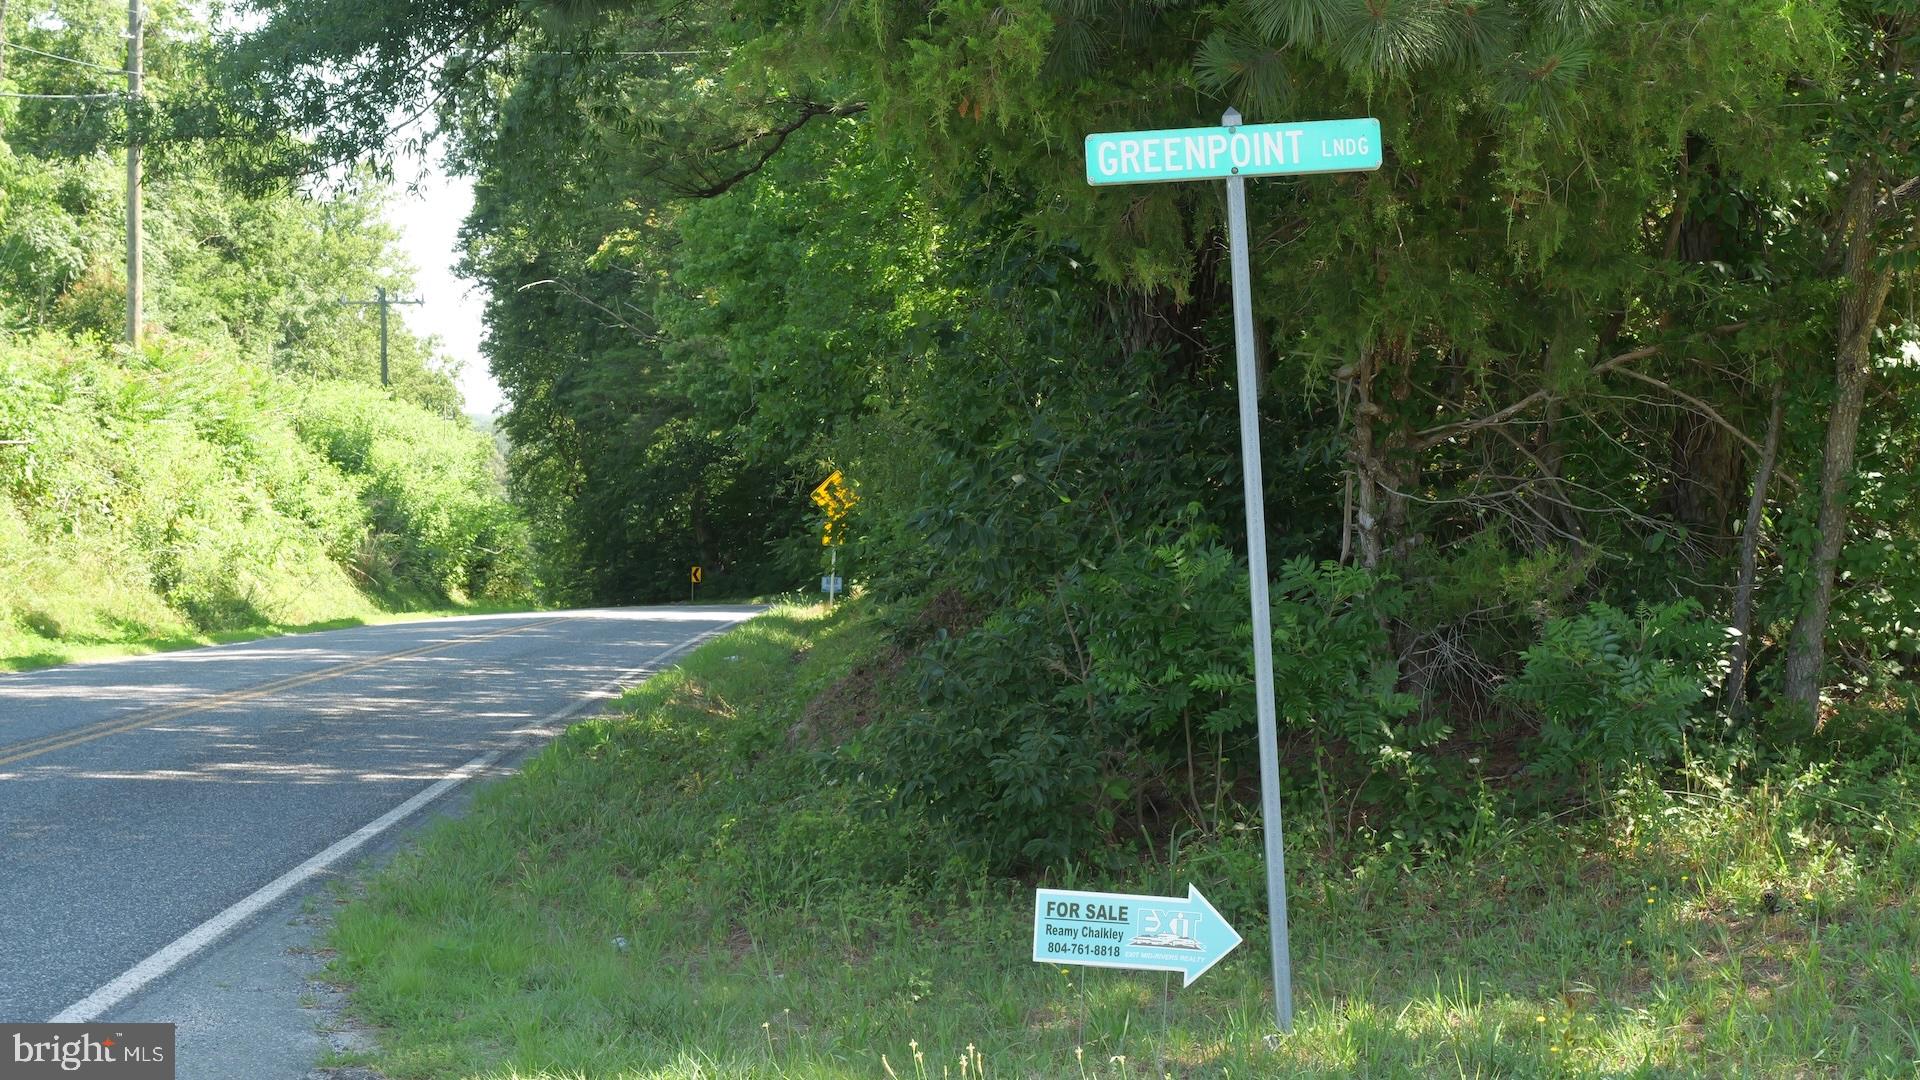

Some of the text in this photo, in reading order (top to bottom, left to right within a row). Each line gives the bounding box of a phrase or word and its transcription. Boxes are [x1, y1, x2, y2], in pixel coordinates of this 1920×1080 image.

[1097, 130, 1369, 175] GREENPOINT LNDG
[1046, 901, 1129, 921] FOR SALE
[1045, 924, 1124, 943] Reamy Chalkley
[1047, 943, 1120, 957] 804-761-8818
